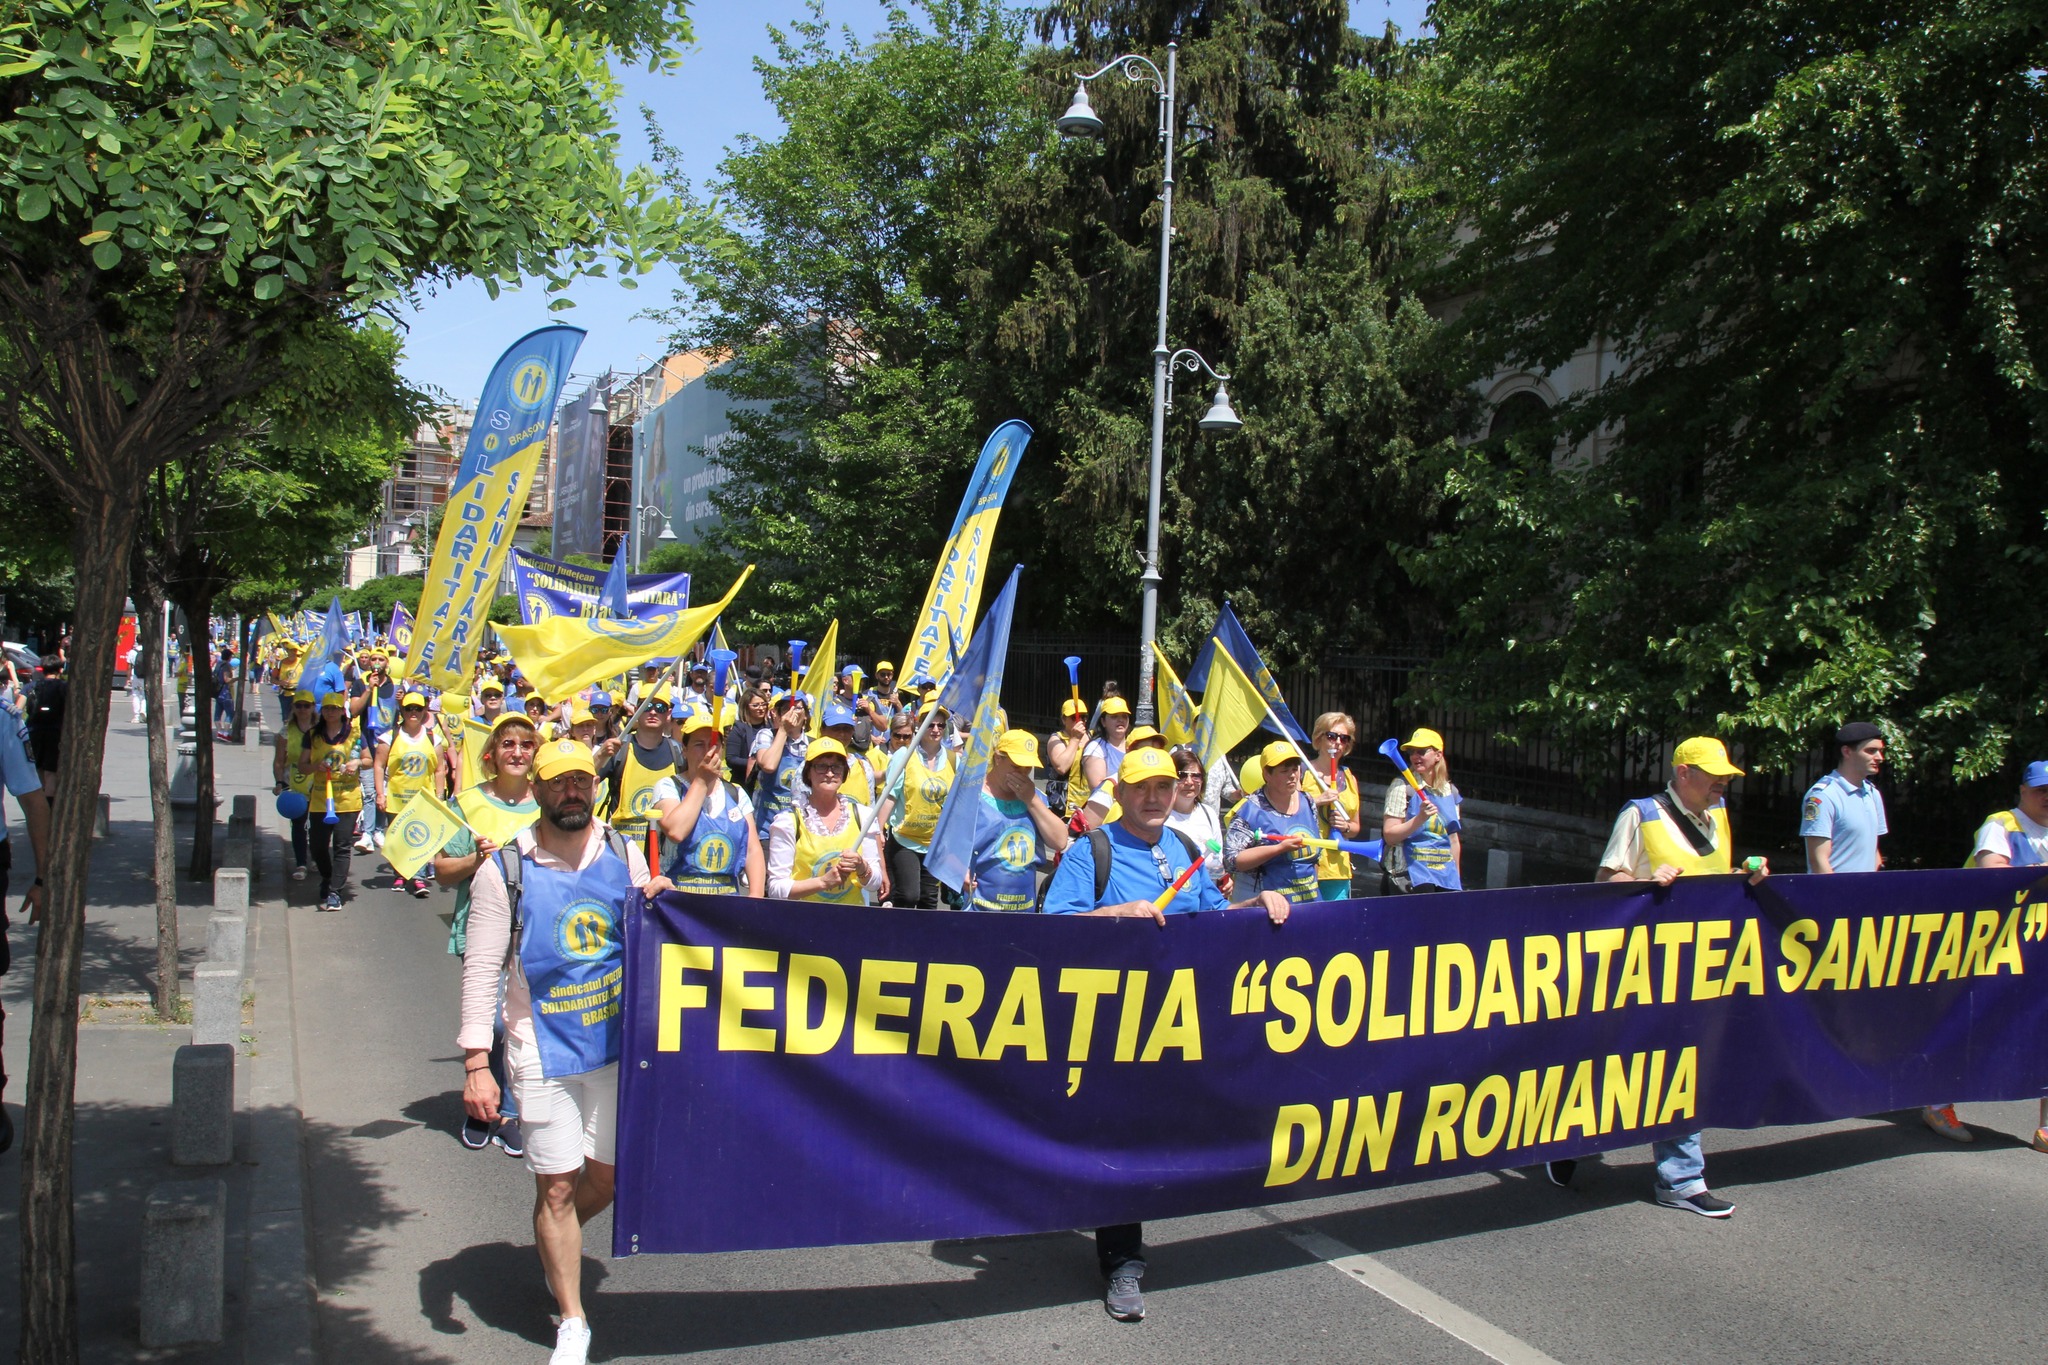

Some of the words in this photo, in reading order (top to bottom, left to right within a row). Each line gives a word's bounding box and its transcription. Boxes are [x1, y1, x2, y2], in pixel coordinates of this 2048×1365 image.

[508, 420, 546, 446] BRAȘOV
[445, 471, 521, 676] SANITARĂ
[549, 977, 602, 999] Sindicatul
[656, 942, 1203, 1098] FEDERAȚIA
[1230, 917, 1764, 1054] “SOLIDARITATEA
[1776, 889, 2048, 993] SANITARĂ”
[541, 989, 610, 1015] SOLIDARITATEA
[582, 1001, 620, 1027] BRAȘOV
[1263, 1090, 1403, 1188] DIN
[1413, 1045, 1698, 1166] ROMANIA
